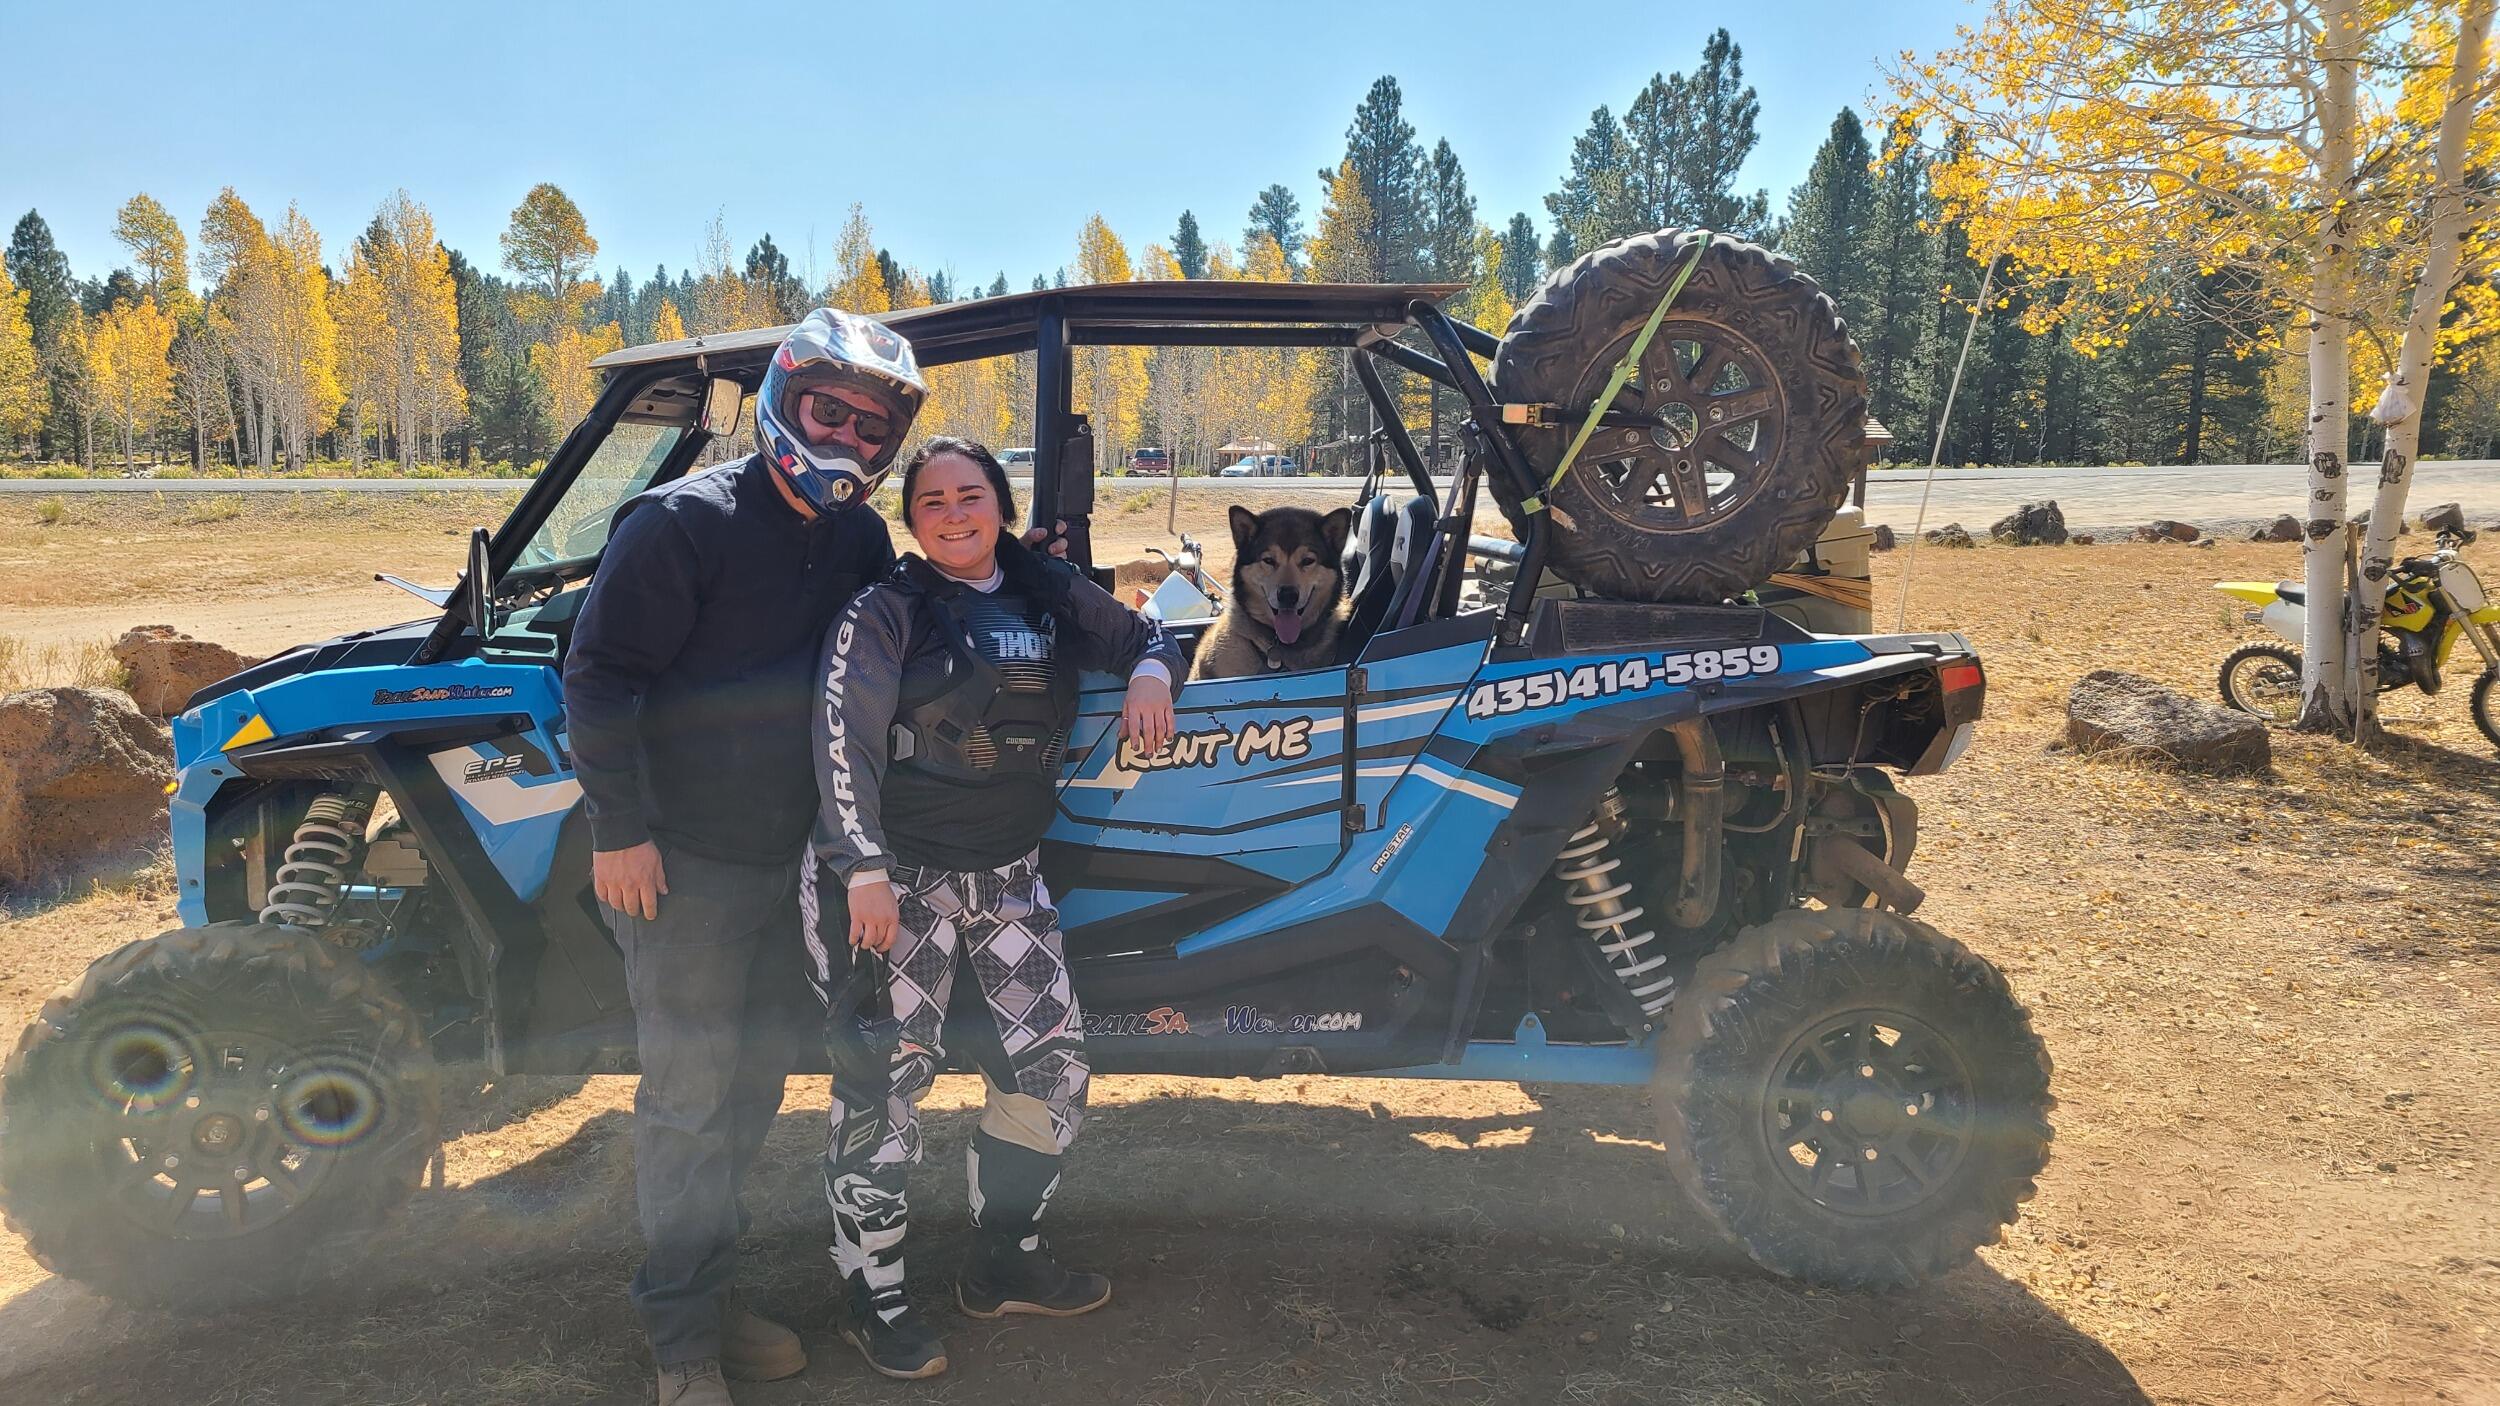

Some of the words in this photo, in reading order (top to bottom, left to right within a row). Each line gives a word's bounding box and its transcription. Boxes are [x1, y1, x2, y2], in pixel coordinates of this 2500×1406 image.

[1467, 645, 1780, 717] 435)414-5859
[464, 754, 524, 775] EPS
[1236, 719, 1311, 762] ME
[1370, 822, 1412, 875] PROSTAR
